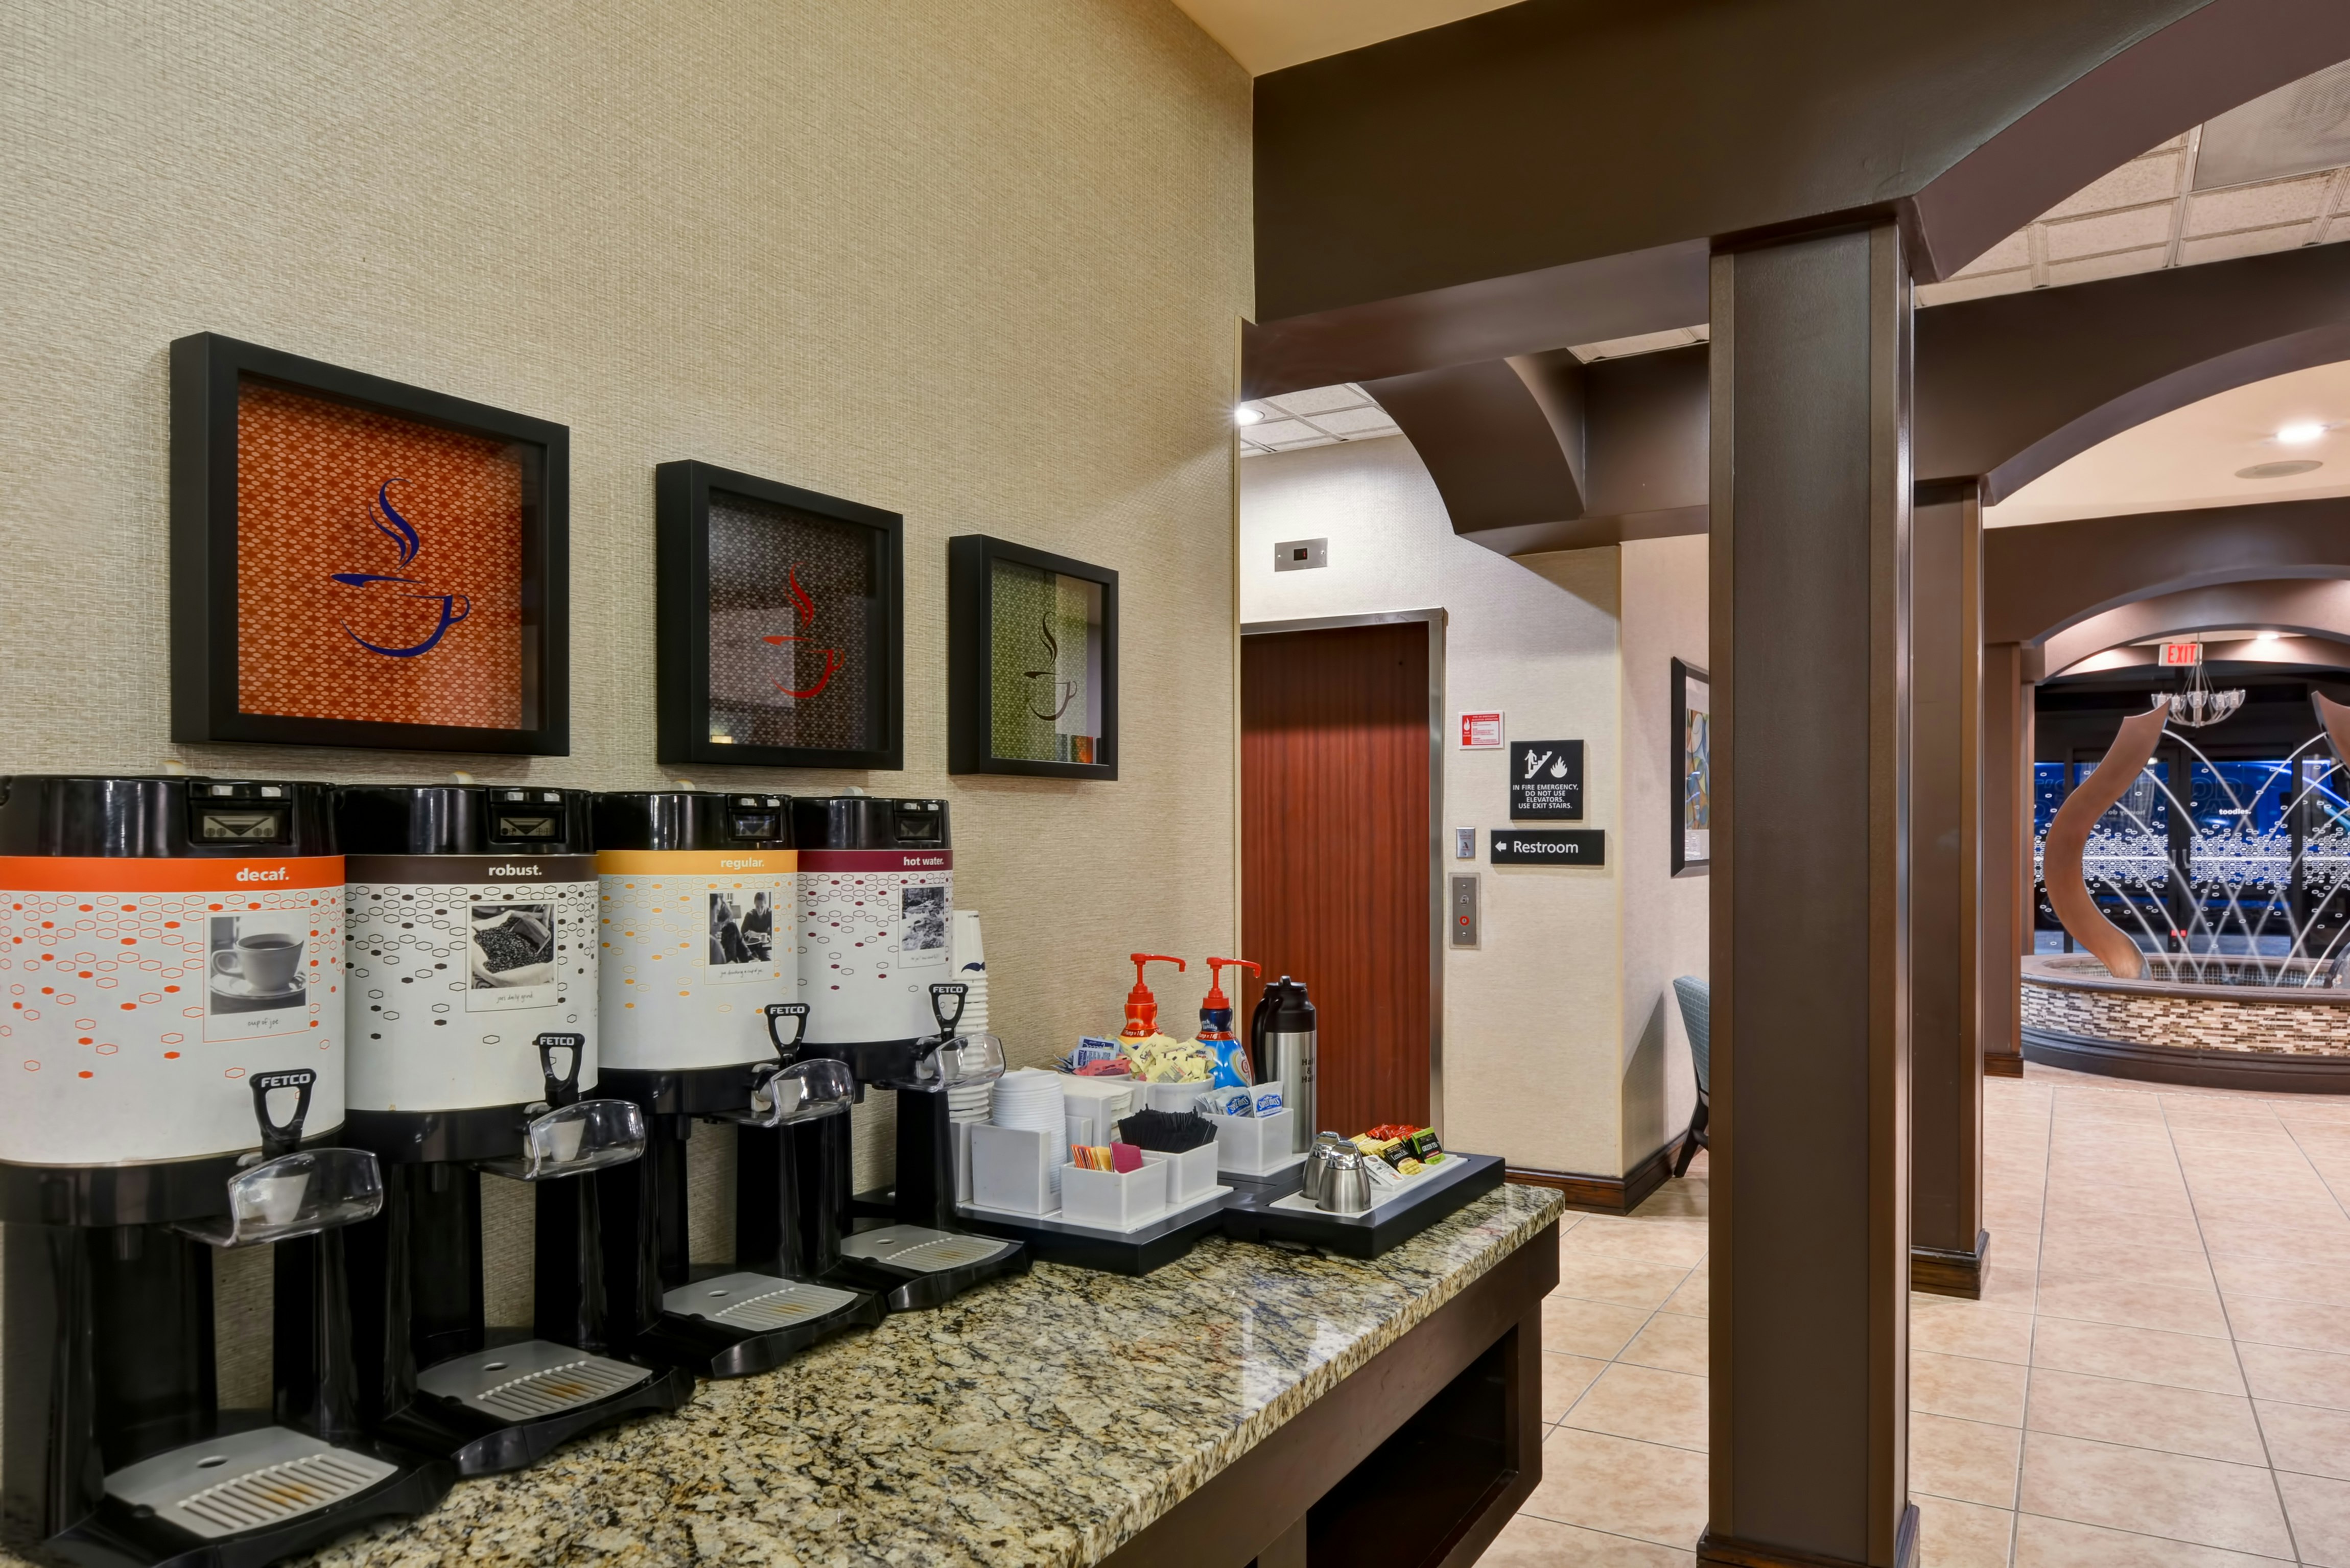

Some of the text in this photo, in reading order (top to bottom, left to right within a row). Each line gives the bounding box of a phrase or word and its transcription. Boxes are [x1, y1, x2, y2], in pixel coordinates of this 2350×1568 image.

[2168, 645, 2196, 663] EXIT
[1514, 841, 1579, 853] Restroom
[721, 857, 765, 870] regular.
[903, 857, 944, 866] hot water.
[236, 867, 290, 882] decaf.
[488, 864, 542, 876] robust.
[770, 1006, 805, 1014] FETCO
[540, 1036, 575, 1046] FETCO
[261, 1073, 311, 1088] FETCO
